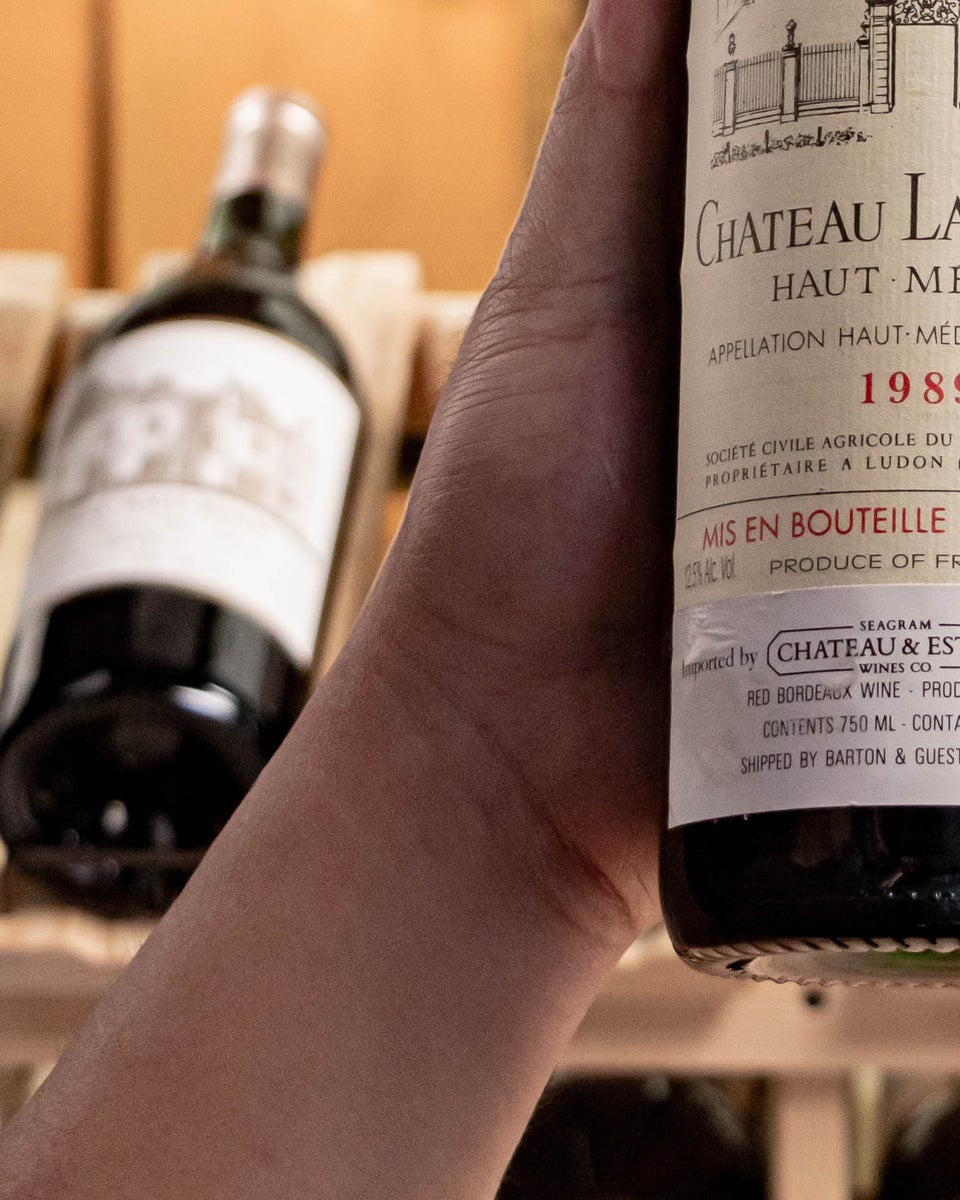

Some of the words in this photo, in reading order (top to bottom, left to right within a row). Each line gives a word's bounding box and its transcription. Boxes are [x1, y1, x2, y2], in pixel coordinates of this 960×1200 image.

[697, 199, 886, 266] CHATEAU
[708, 329, 824, 366] APPELLATION
[706, 442, 757, 467] SOCIÉTÉ
[762, 437, 814, 455] CIVILE
[822, 433, 916, 449] AGRICOLE
[927, 433, 952, 446] DU
[706, 458, 828, 488] PROPRIÉTAIRE
[842, 458, 851, 470] A
[867, 456, 942, 469] LUDON
[703, 520, 736, 550] MIS
[746, 514, 779, 543] EN
[792, 507, 945, 538] BOUTEILLE
[770, 554, 883, 575] PRODUCE
[892, 554, 925, 568] OF
[860, 620, 931, 631] SEAGRAM
[682, 647, 735, 679] Imported
[740, 646, 758, 671] by
[777, 637, 895, 662] CHATEAU
[902, 638, 920, 655] &
[859, 663, 904, 673] WINES
[747, 688, 770, 707] RED
[778, 684, 852, 704] BORDEAUX
[861, 681, 900, 698] WINE
[763, 716, 833, 738] CONTENTS
[840, 715, 868, 733] 750
[875, 715, 896, 731] ML
[741, 753, 792, 774] SHIPPED
[800, 751, 817, 768] BY
[826, 748, 886, 767] BARTON
[895, 748, 905, 765] &
